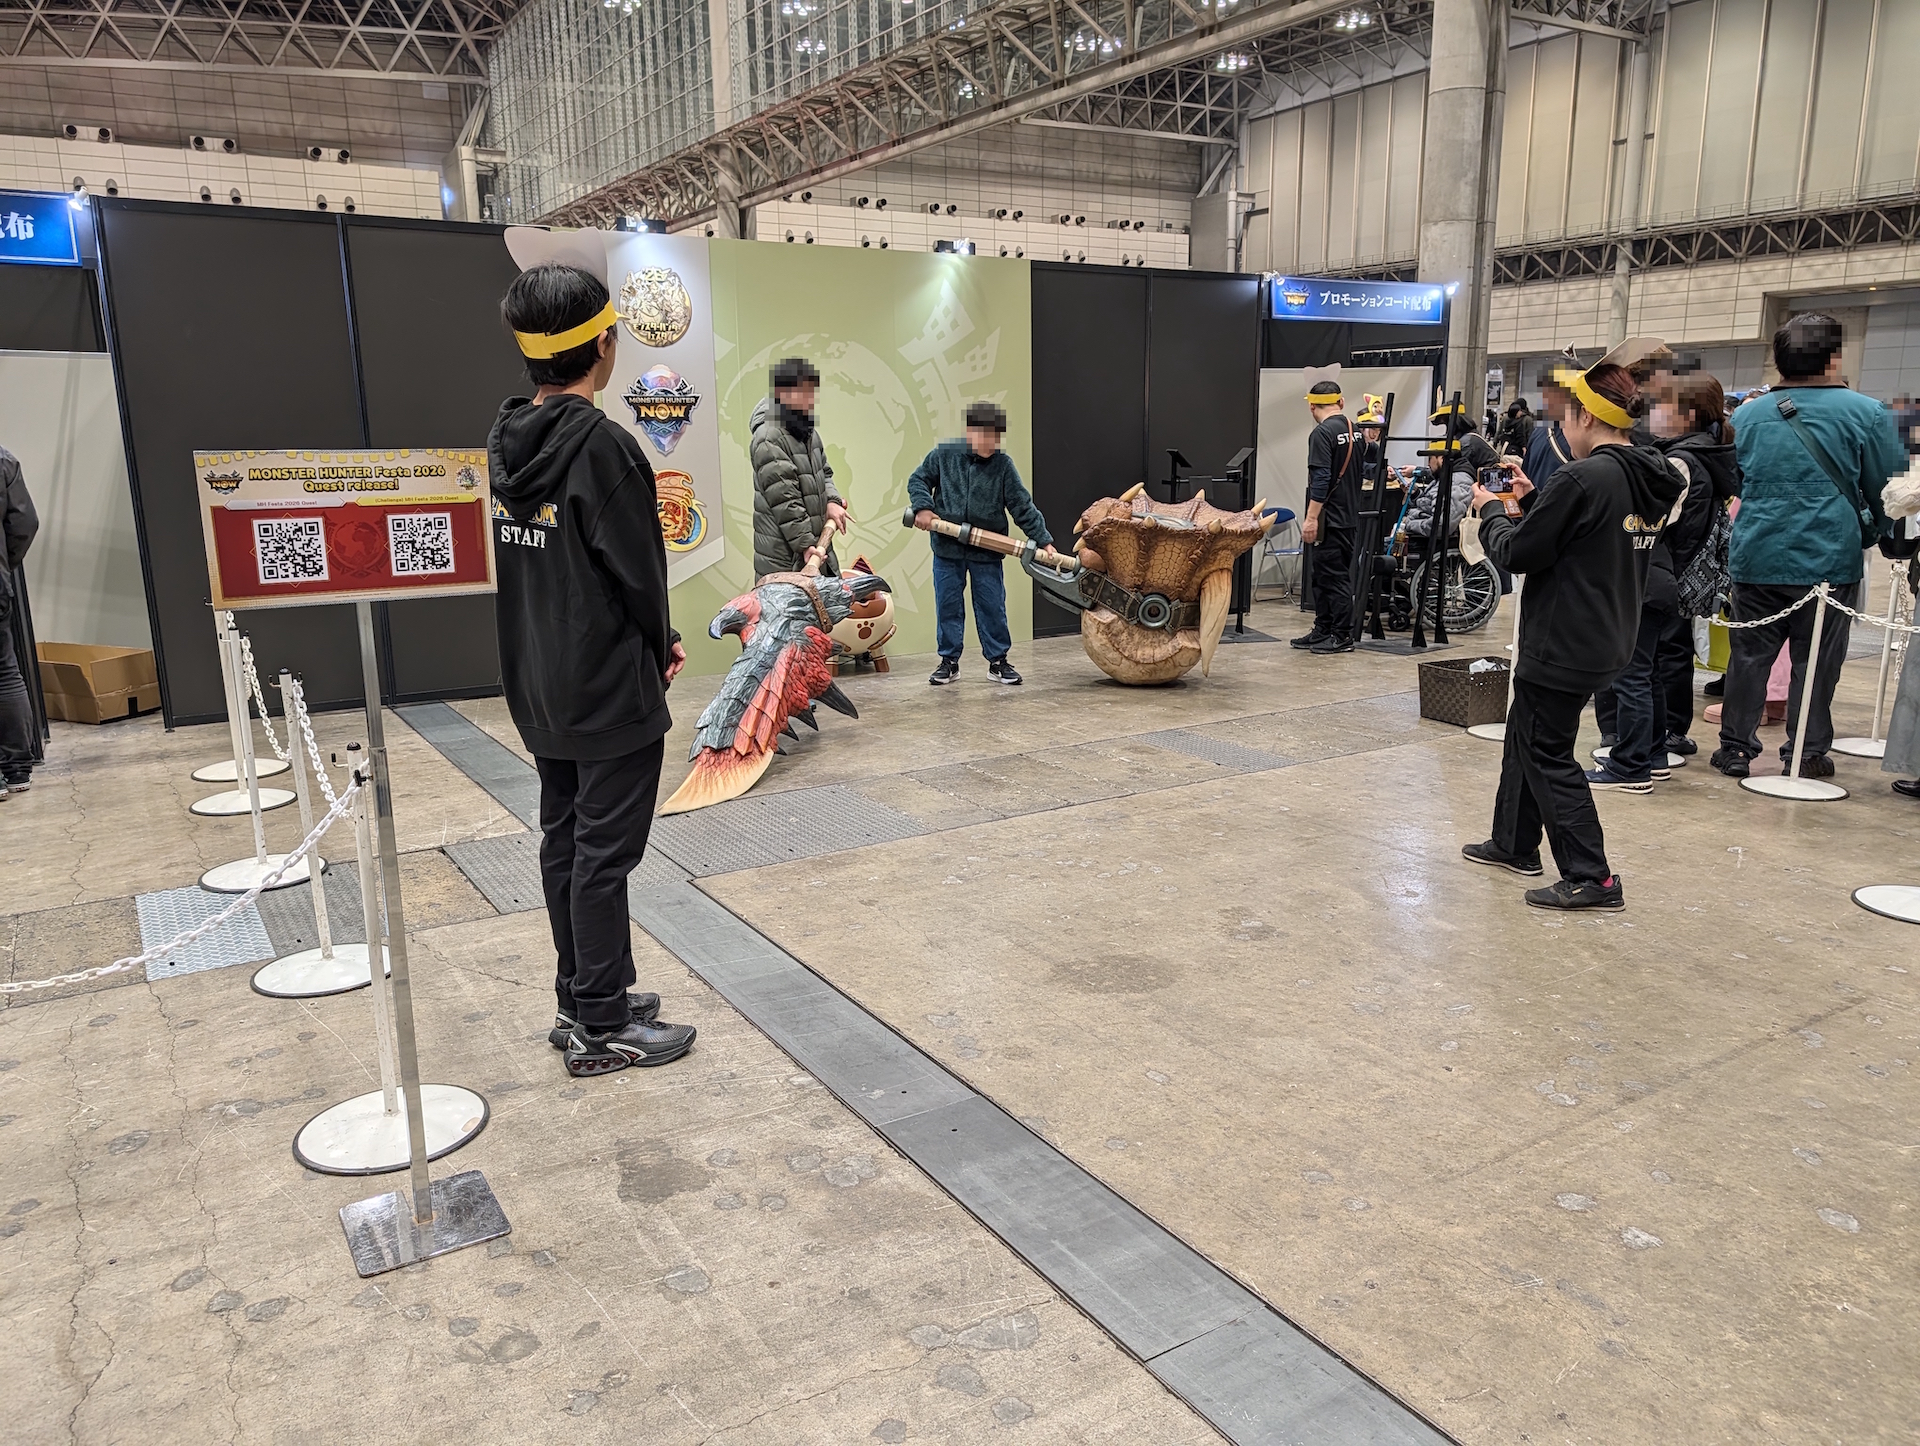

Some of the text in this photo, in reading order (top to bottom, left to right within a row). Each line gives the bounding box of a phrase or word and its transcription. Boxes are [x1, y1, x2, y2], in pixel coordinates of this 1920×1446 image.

[1319, 290, 1433, 311] プロモーションコード配布
[639, 403, 687, 420] NOW
[248, 464, 446, 481] MONSTER HUNTER Festa 2026
[212, 481, 237, 489] NOW
[303, 479, 400, 493] Quest release!
[500, 524, 546, 549] STAFF
